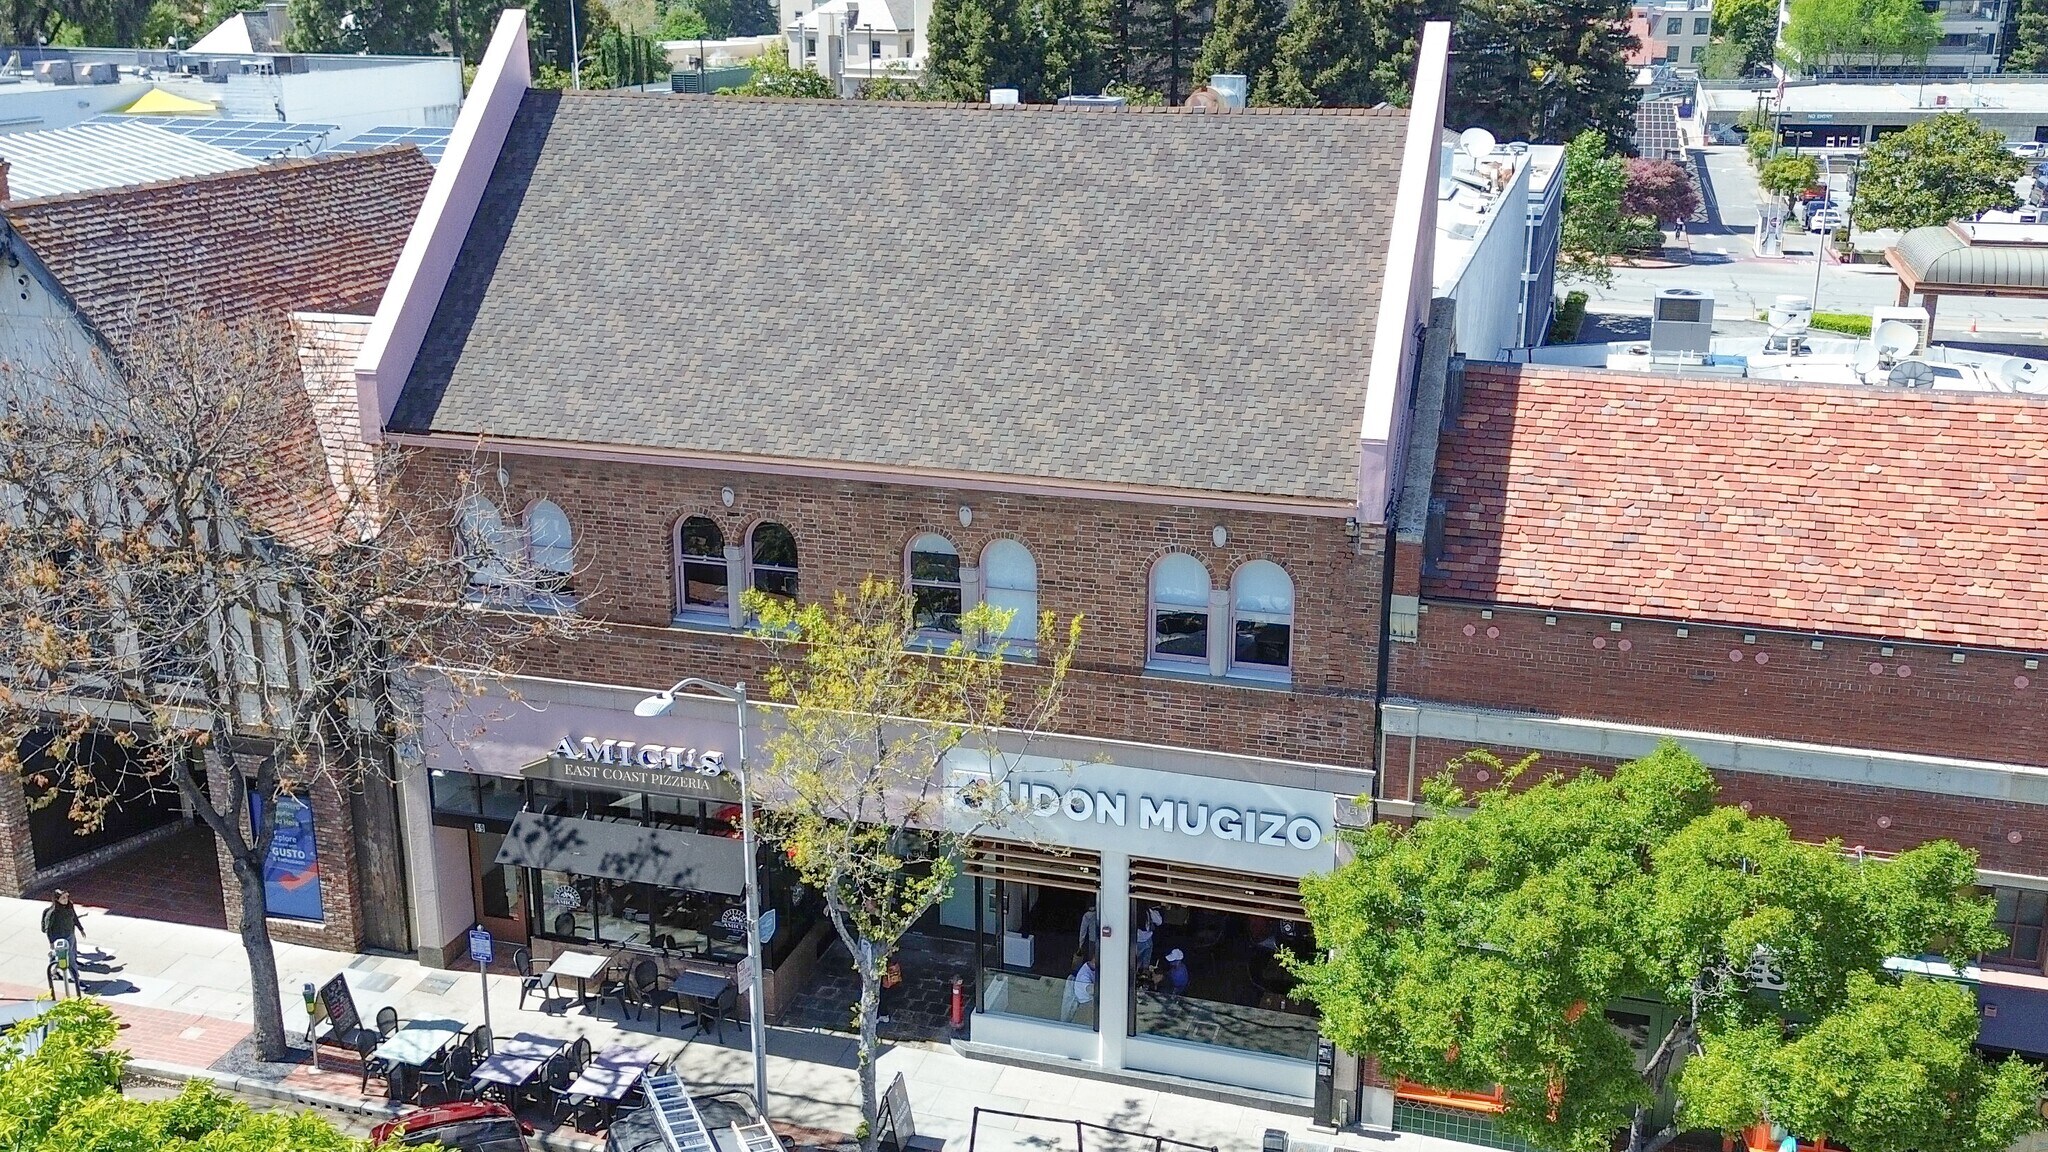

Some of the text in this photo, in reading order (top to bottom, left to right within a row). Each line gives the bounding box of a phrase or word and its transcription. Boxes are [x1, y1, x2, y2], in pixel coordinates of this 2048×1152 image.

[548, 734, 724, 777] AMICI'S
[564, 763, 710, 790] EAST COAST PIZZERIA
[1001, 779, 1323, 851] UDON MUGIZO
[274, 835, 297, 843] xplore
[271, 847, 306, 859] GUSTO
